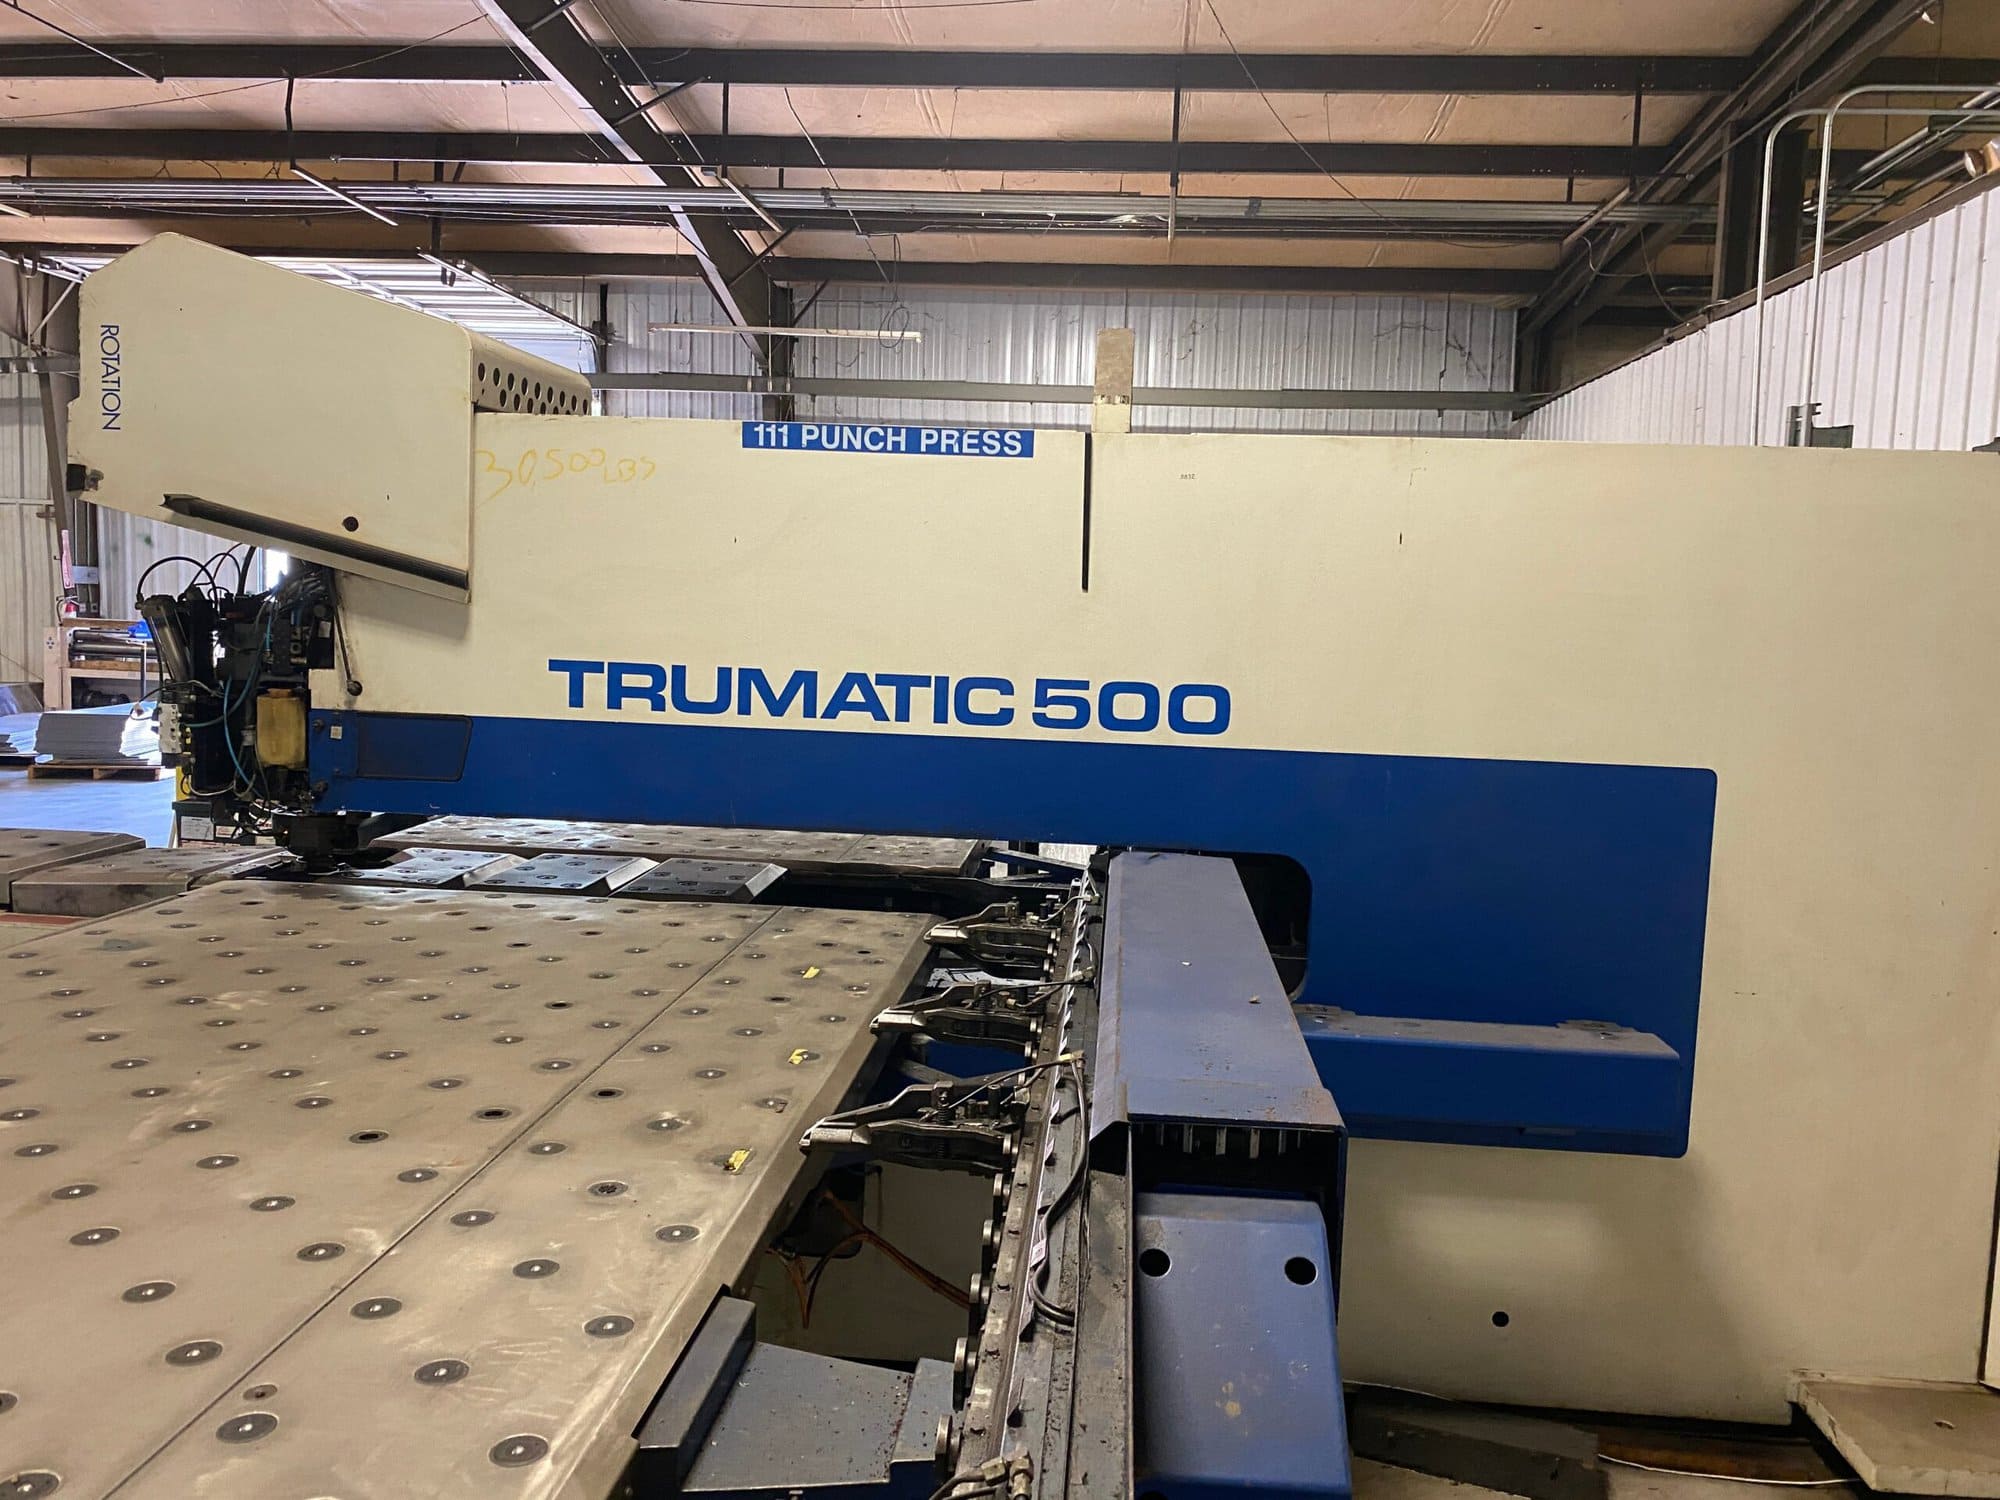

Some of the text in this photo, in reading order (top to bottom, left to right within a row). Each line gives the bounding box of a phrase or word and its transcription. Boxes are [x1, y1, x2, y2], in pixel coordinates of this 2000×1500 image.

[100, 324, 121, 430] ROTATION
[753, 424, 1022, 455] 111 PUNCH PRESS
[548, 659, 1231, 735] TRUMATIC 500
